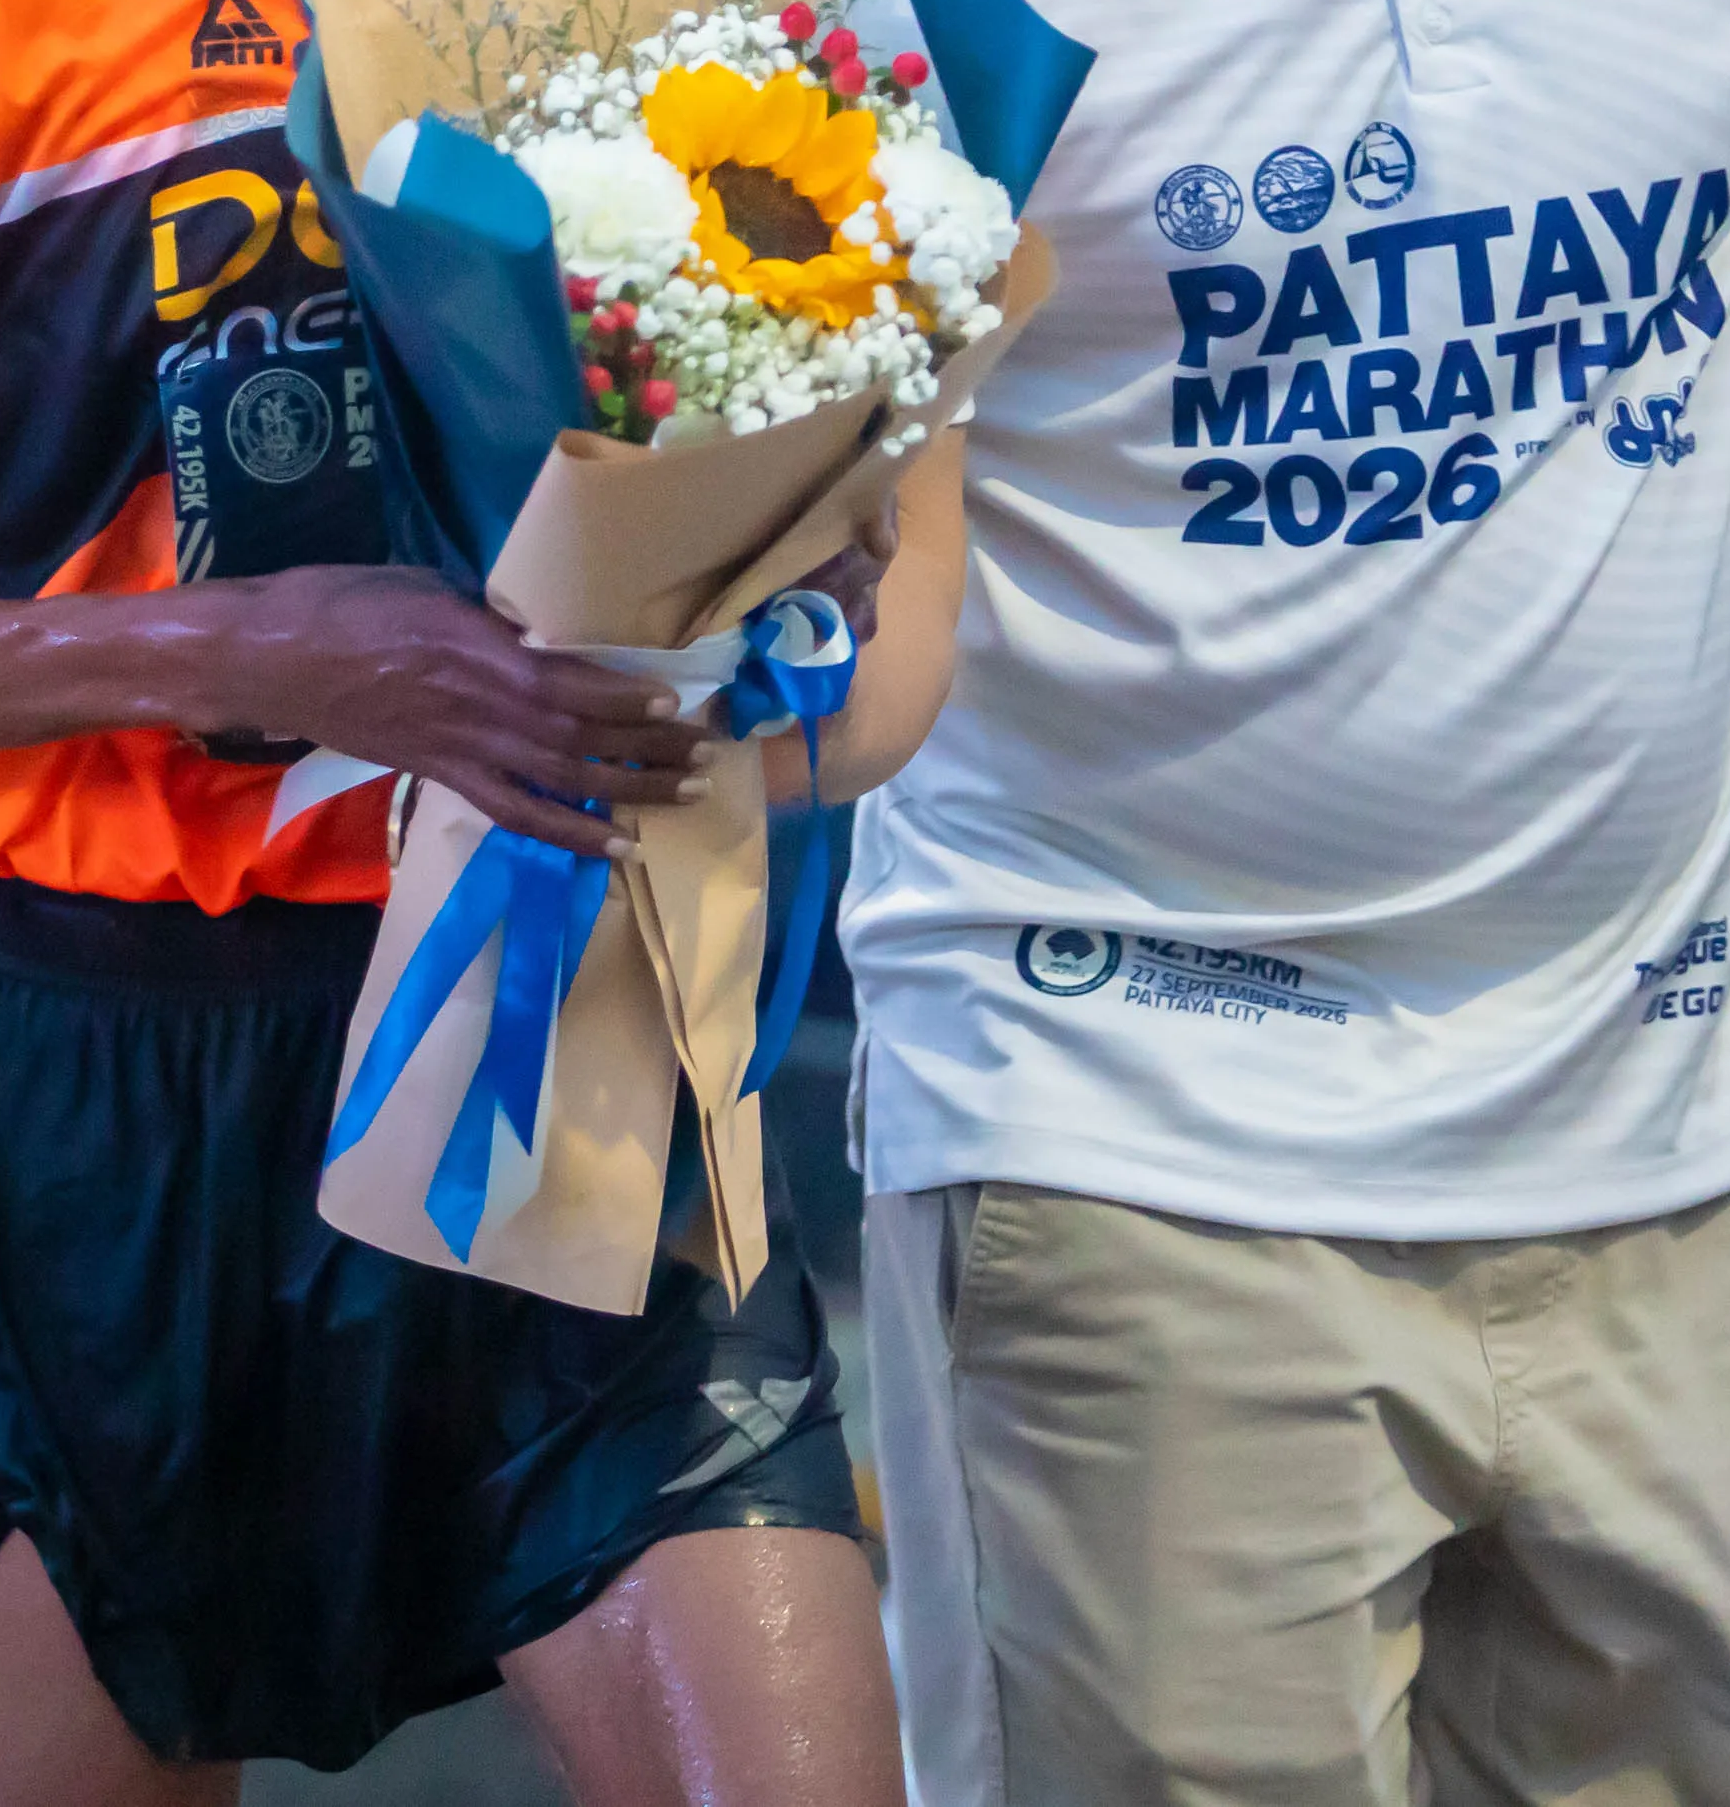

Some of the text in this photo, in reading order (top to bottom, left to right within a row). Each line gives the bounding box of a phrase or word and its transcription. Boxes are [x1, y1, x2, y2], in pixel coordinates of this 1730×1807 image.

[1180, 431, 1502, 548] 2026
[1124, 983, 1268, 1025] PATTAYA CITY
[1129, 964, 1157, 985] 27
[1157, 971, 1290, 1012] SEPTEMBER
[1294, 1001, 1349, 1025] 2026
